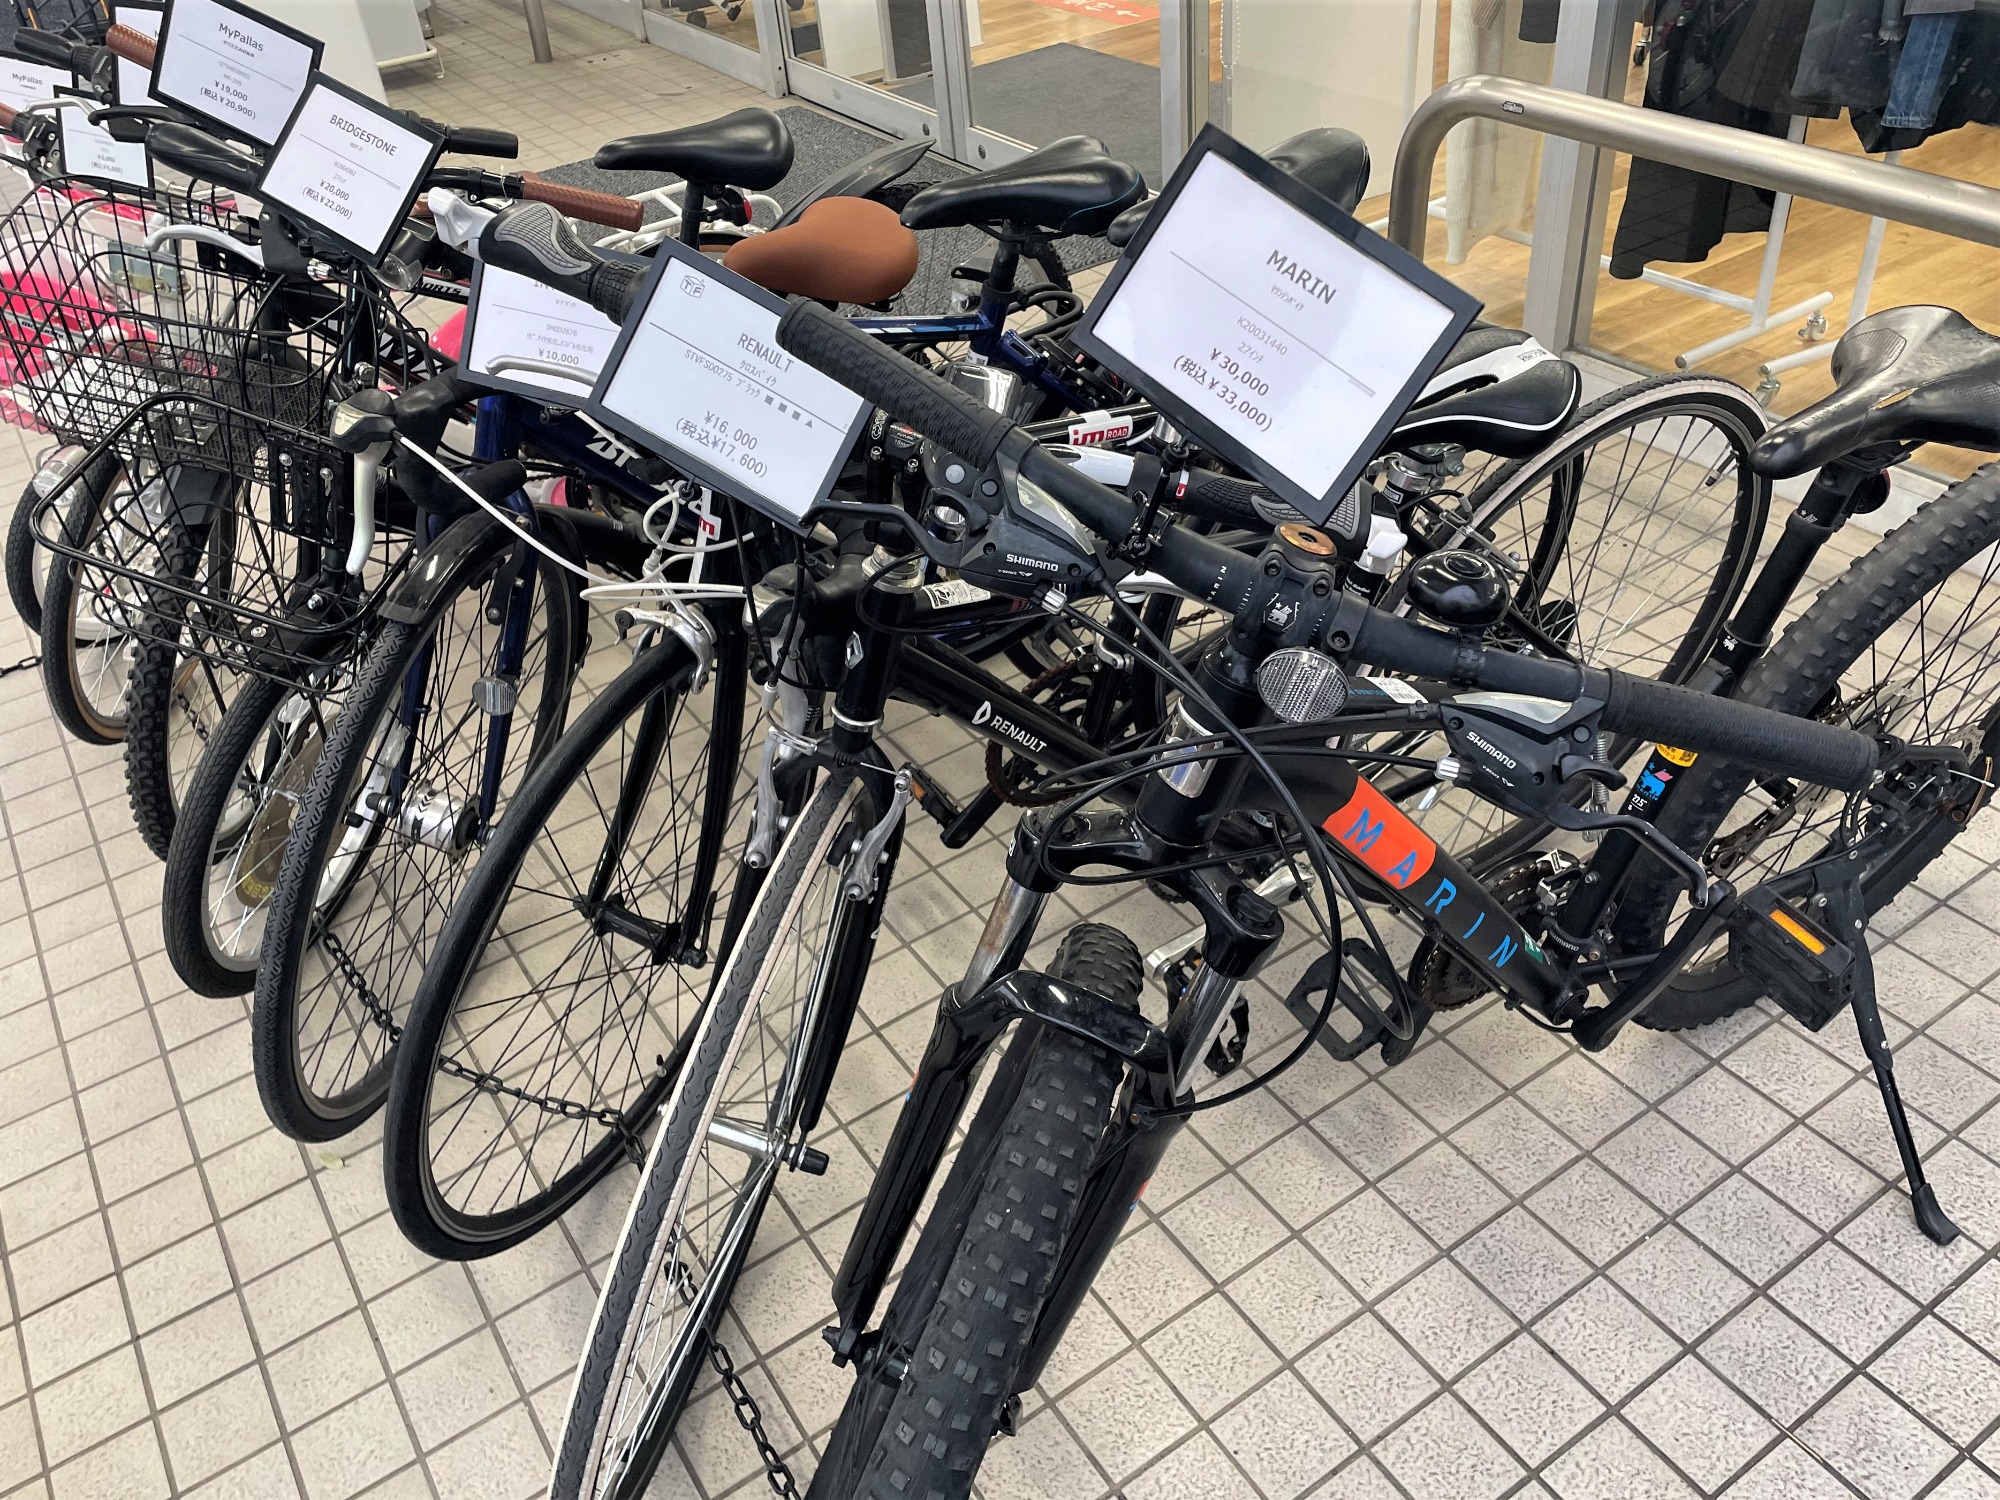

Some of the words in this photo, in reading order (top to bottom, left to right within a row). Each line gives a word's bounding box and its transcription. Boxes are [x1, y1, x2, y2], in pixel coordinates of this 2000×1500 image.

[219, 23, 264, 52] MyPallas
[12, 73, 43, 85] MyPallas
[214, 80, 248, 101] ¥19,000
[330, 114, 397, 156] BRIDGESTONE
[320, 179, 350, 201] ¥20,000
[1266, 249, 1337, 305] MARIN
[737, 333, 795, 373] RENAULT
[1236, 316, 1288, 356] K20031440
[538, 348, 580, 366] ¥10,000
[684, 349, 733, 382] STVFS00275
[1209, 348, 1269, 396] ¥30,000
[1106, 427, 1129, 440] ROAD
[1006, 554, 1058, 572] SHIMANO
[990, 716, 1047, 753] RENAULT
[1466, 732, 1517, 770] SHIMANO
[1343, 807, 1518, 968] MARIN
